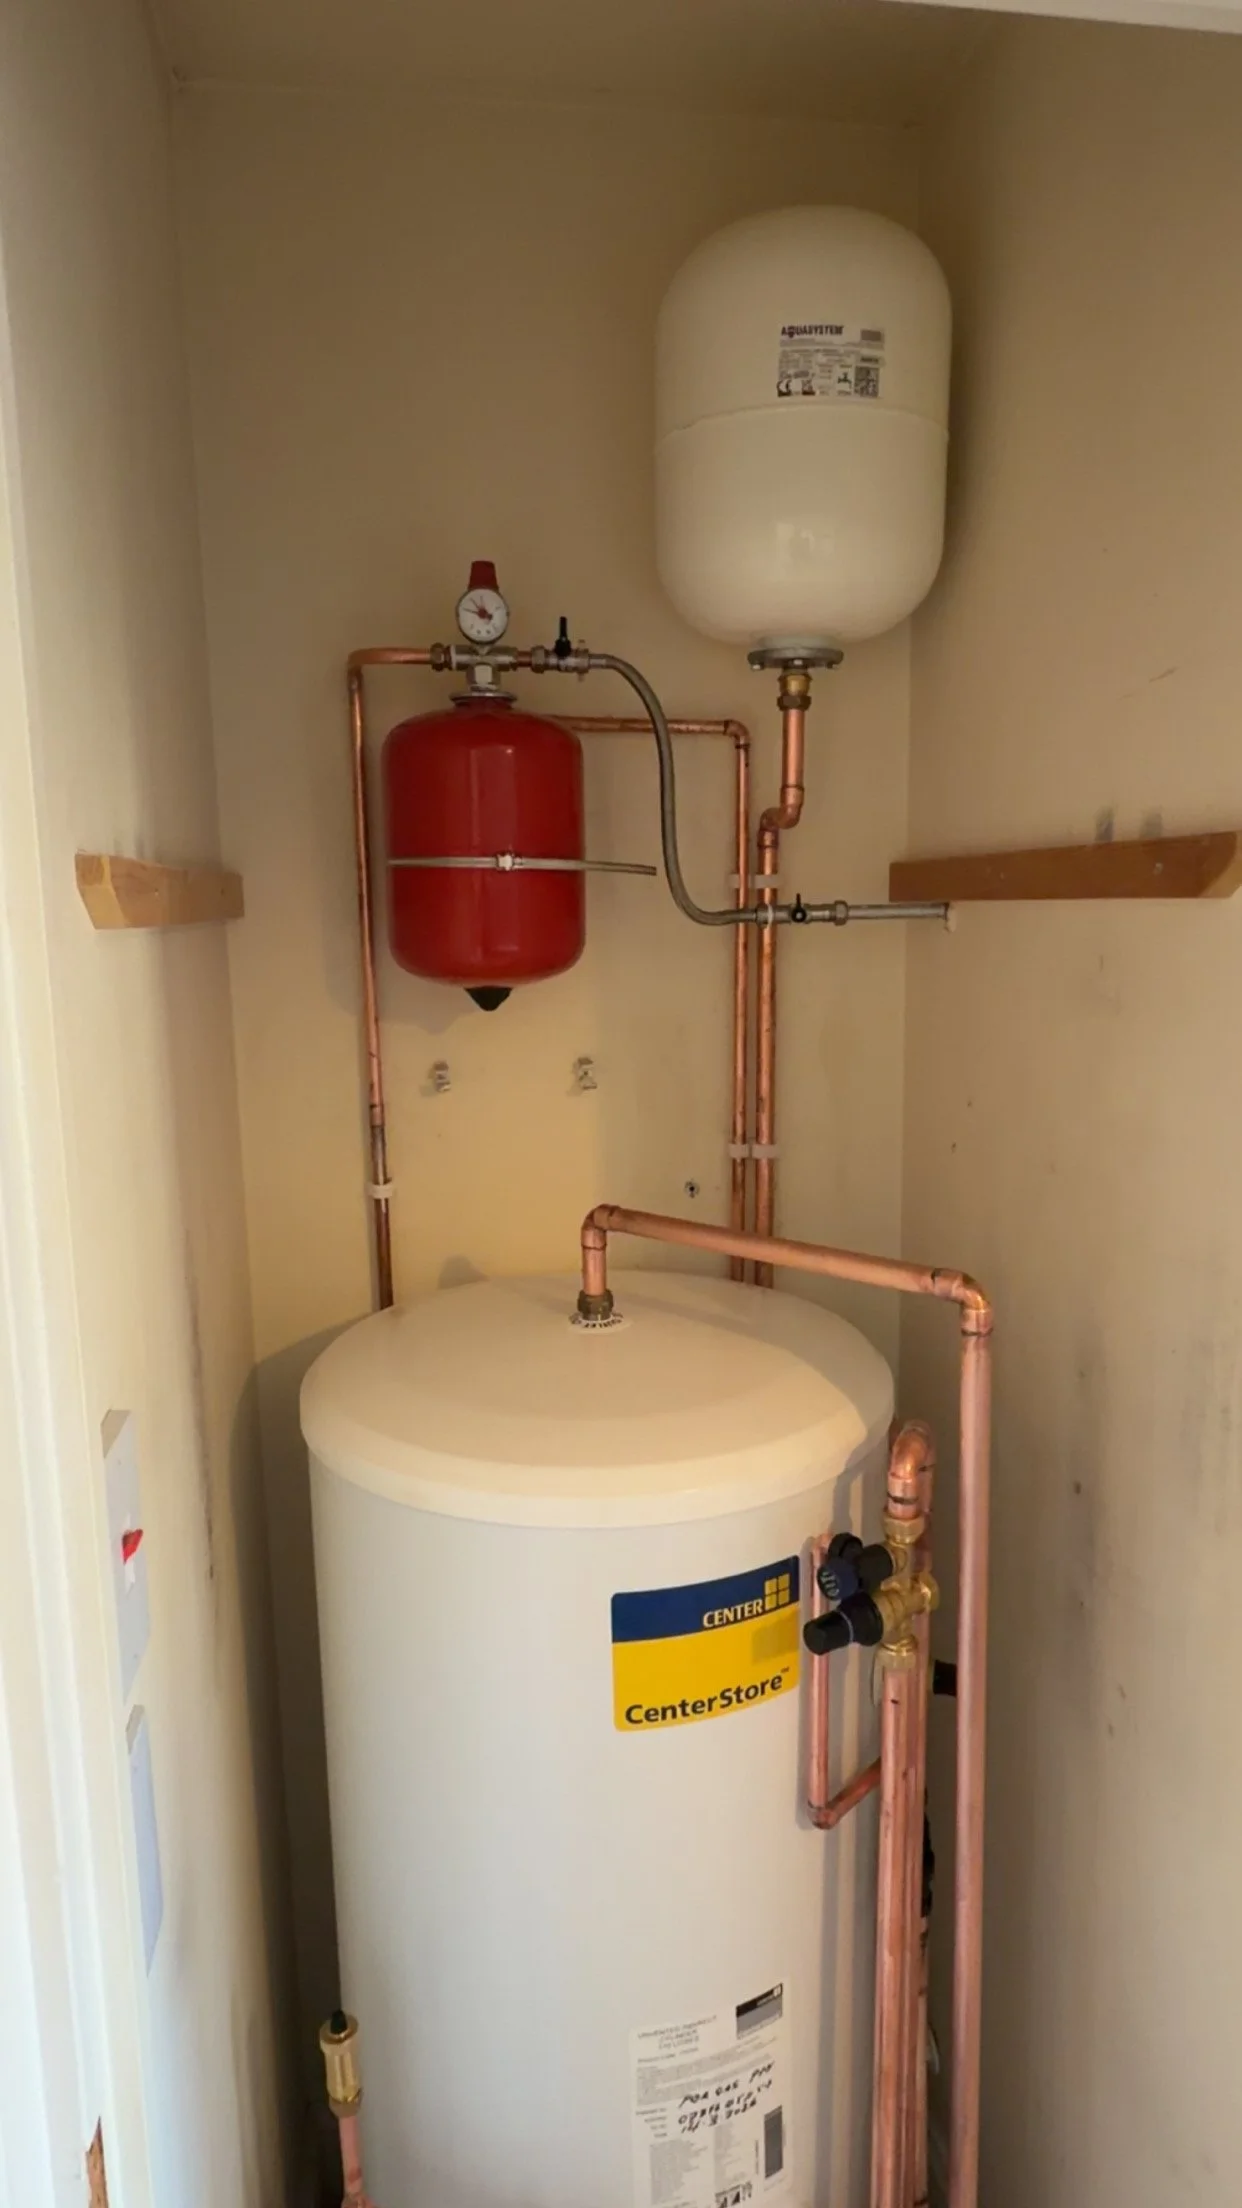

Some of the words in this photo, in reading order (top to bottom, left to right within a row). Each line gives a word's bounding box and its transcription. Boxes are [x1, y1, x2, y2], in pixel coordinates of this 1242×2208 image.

[781, 325, 844, 338] AQUASYSTEM
[702, 1599, 764, 1629] CENTER
[624, 1673, 783, 1725] CenterStore
